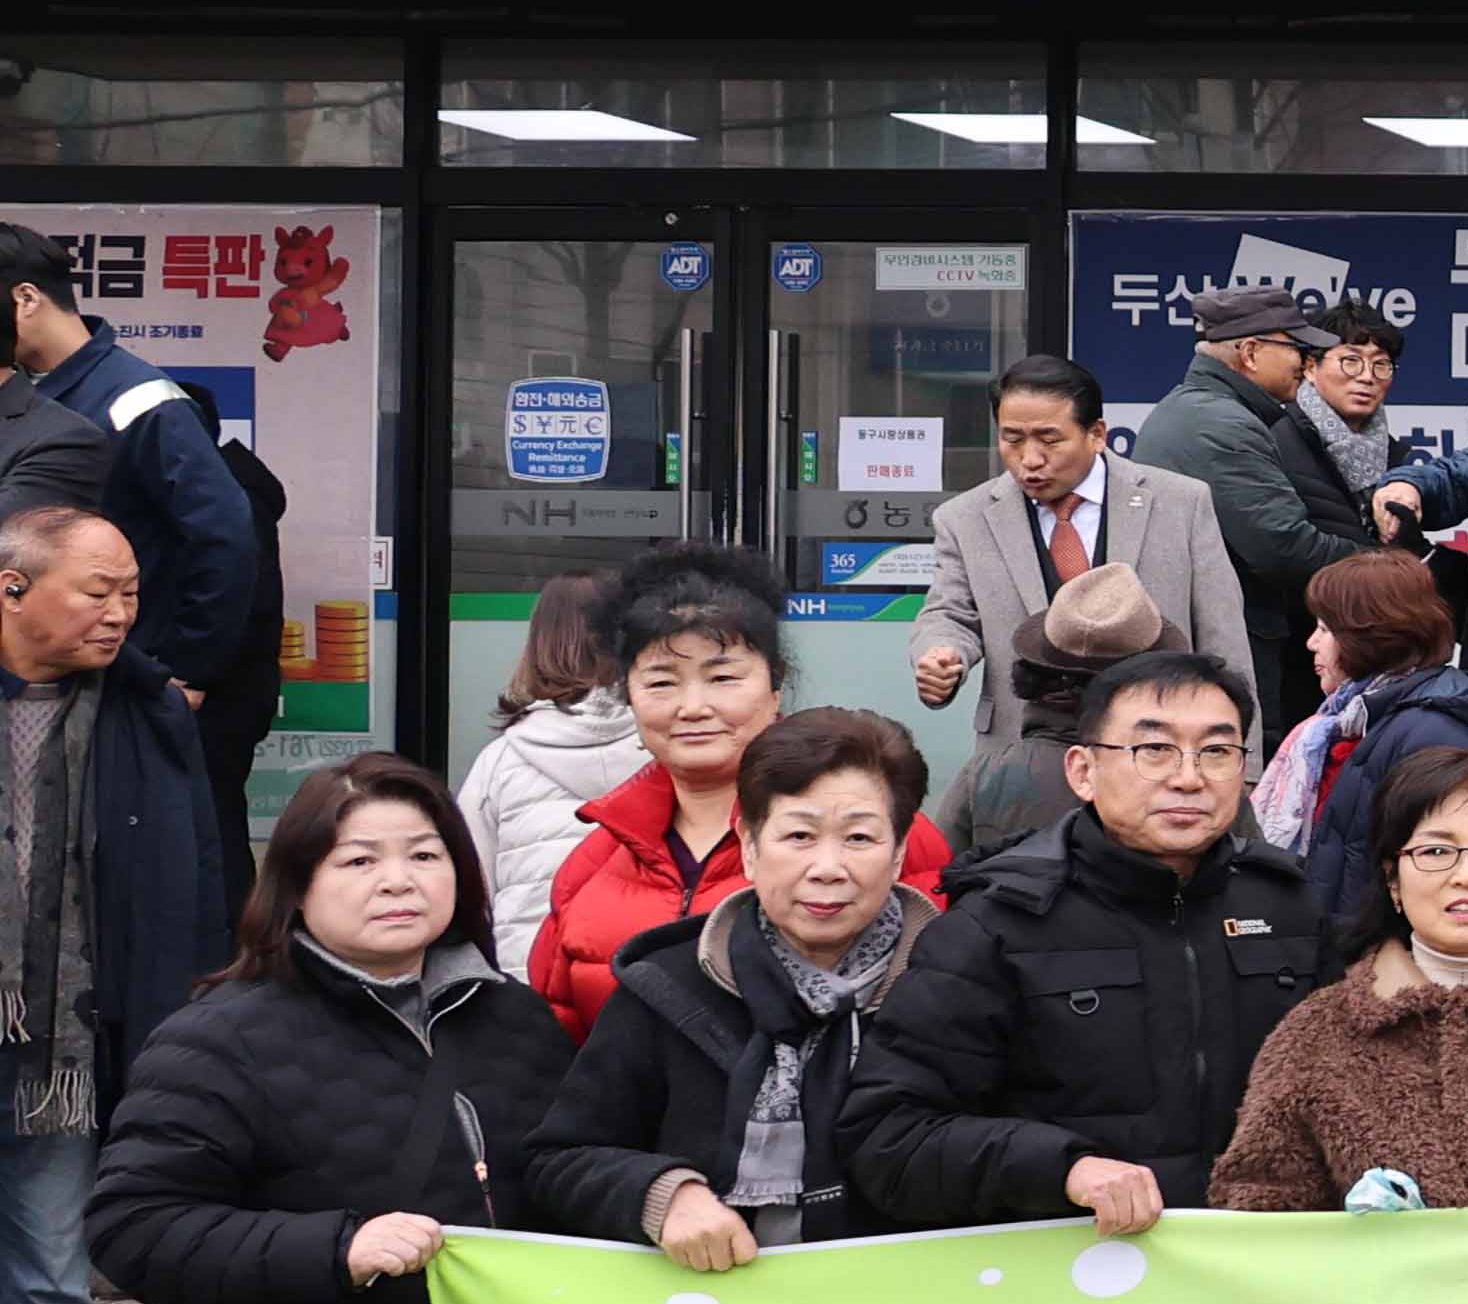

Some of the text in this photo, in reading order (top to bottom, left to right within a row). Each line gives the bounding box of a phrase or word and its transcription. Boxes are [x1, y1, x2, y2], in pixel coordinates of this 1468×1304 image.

[162, 234, 266, 299] 특판
[667, 256, 702, 275] ADT
[779, 258, 814, 277] ADT
[936, 270, 976, 281] CCTV
[830, 553, 857, 568] 365
[787, 598, 827, 616] NH
